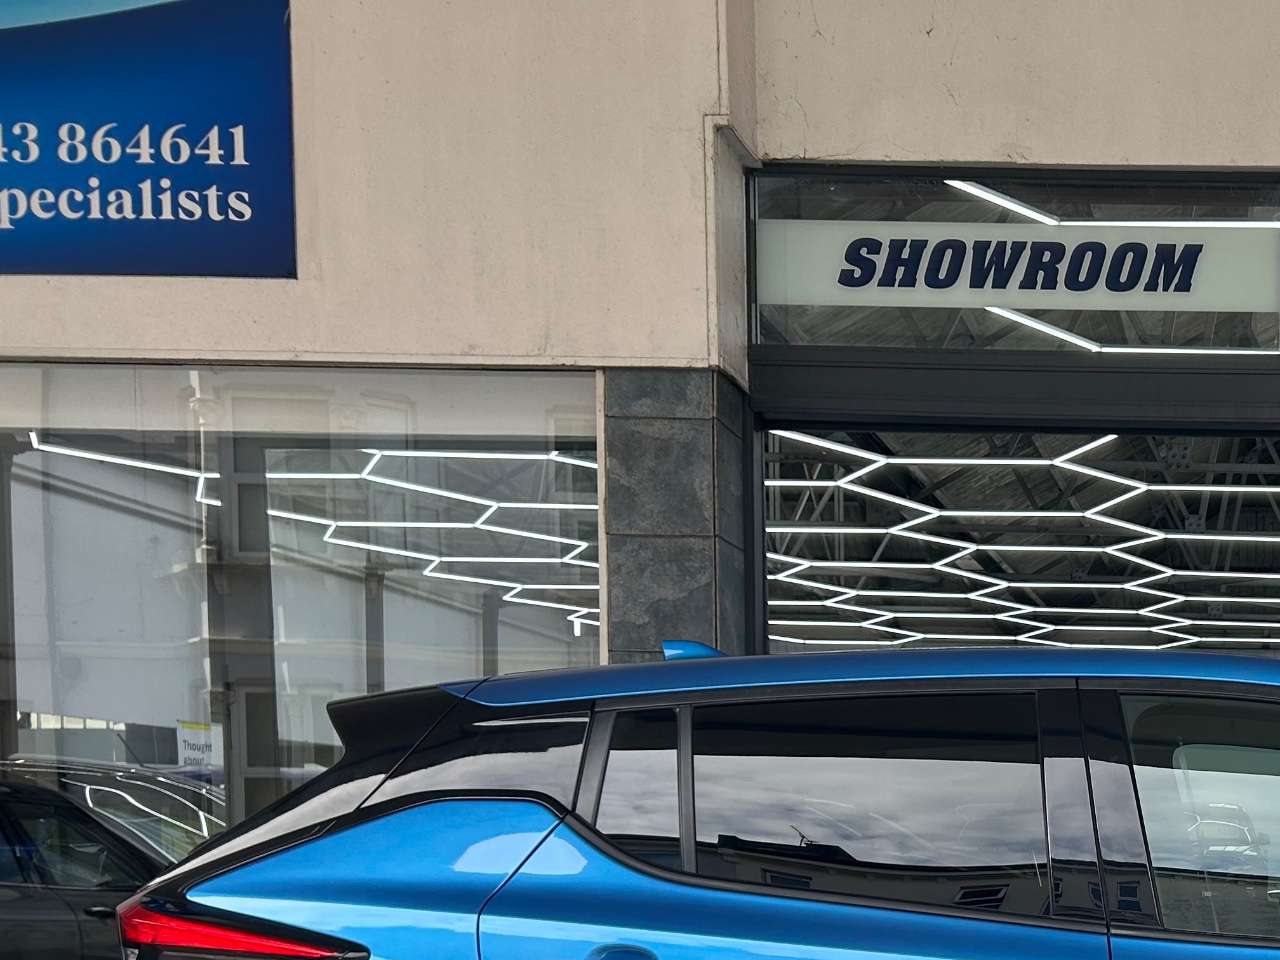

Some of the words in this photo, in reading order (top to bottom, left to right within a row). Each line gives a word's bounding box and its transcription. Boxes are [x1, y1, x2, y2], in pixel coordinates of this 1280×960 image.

[0, 122, 40, 163] 3
[57, 122, 250, 165] 864641
[0, 176, 252, 229] pecialists
[837, 237, 1204, 293] SHOWROOM
[183, 740, 212, 754] Thought
